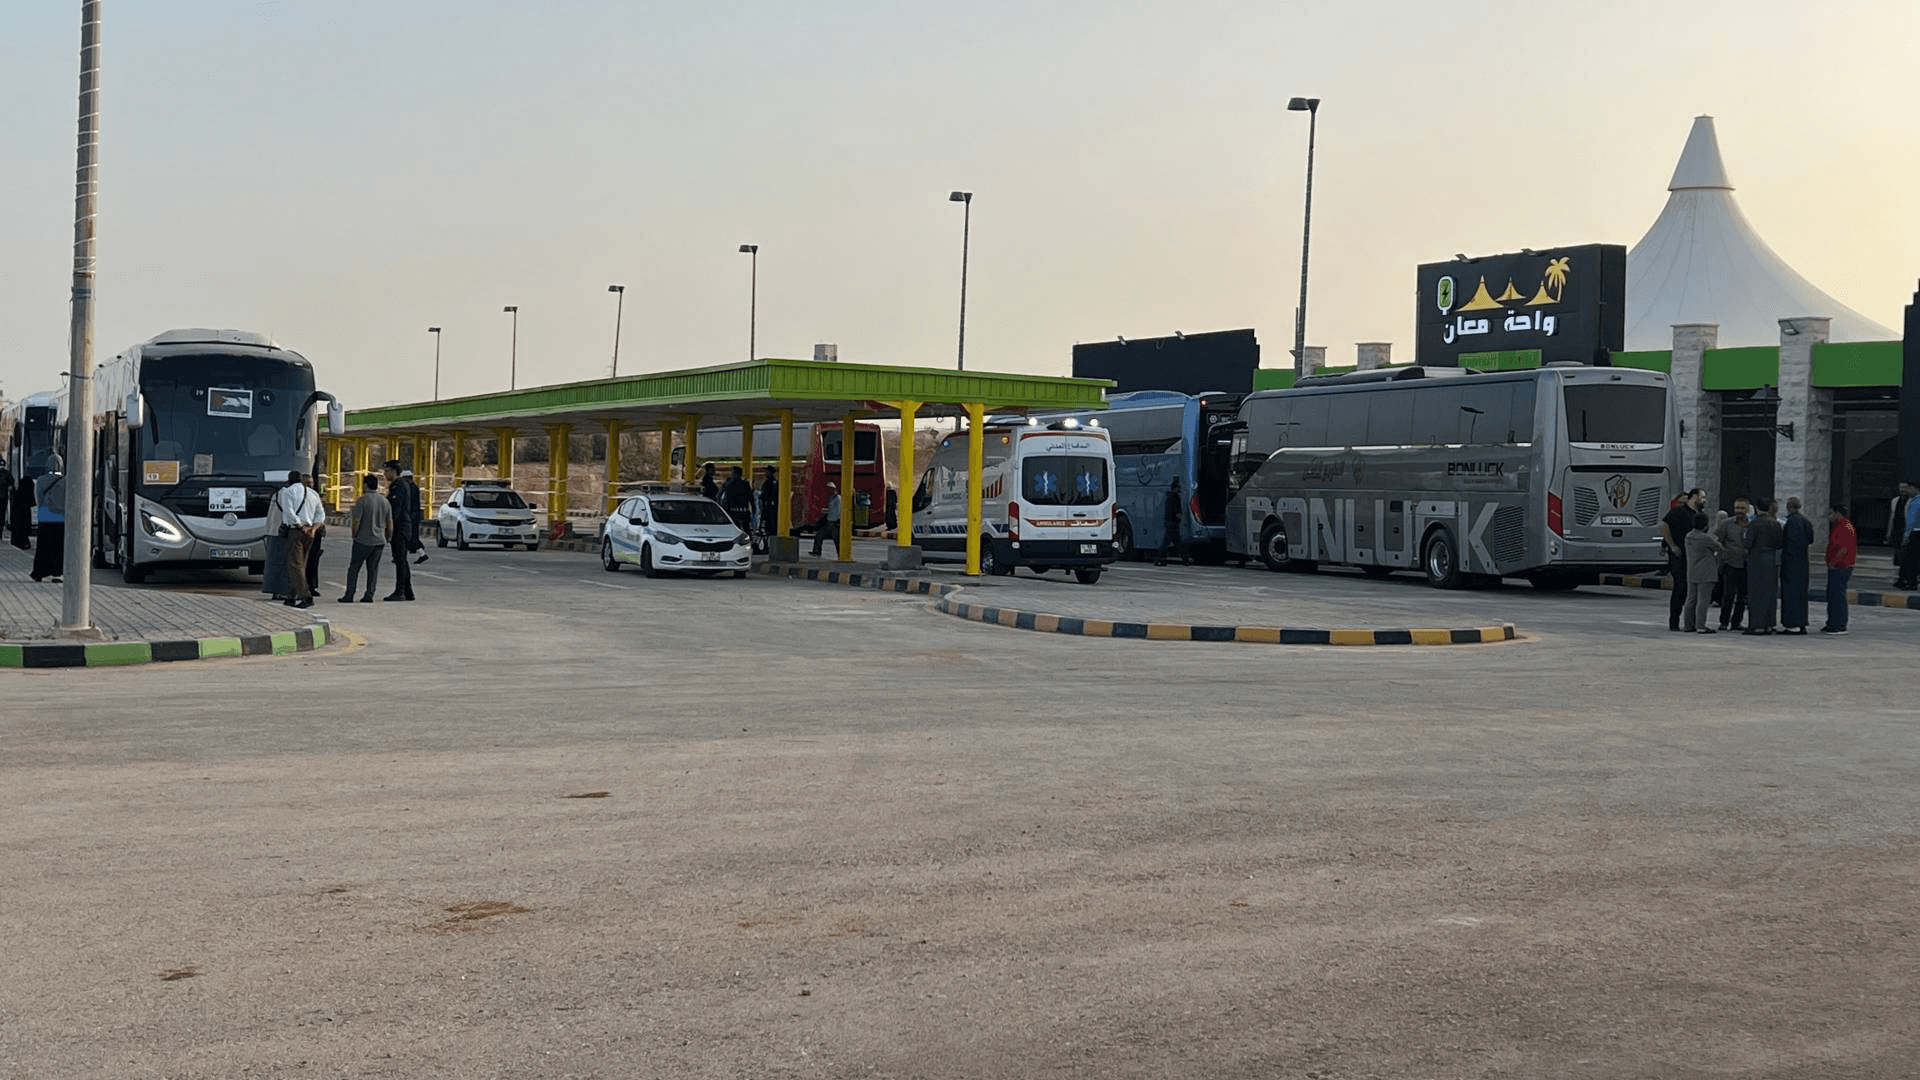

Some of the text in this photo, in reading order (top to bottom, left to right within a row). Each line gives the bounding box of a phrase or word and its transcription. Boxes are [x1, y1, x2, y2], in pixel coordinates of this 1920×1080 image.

[1443, 310, 1555, 344] واحة معان
[1448, 462, 1504, 476] BONLUCK
